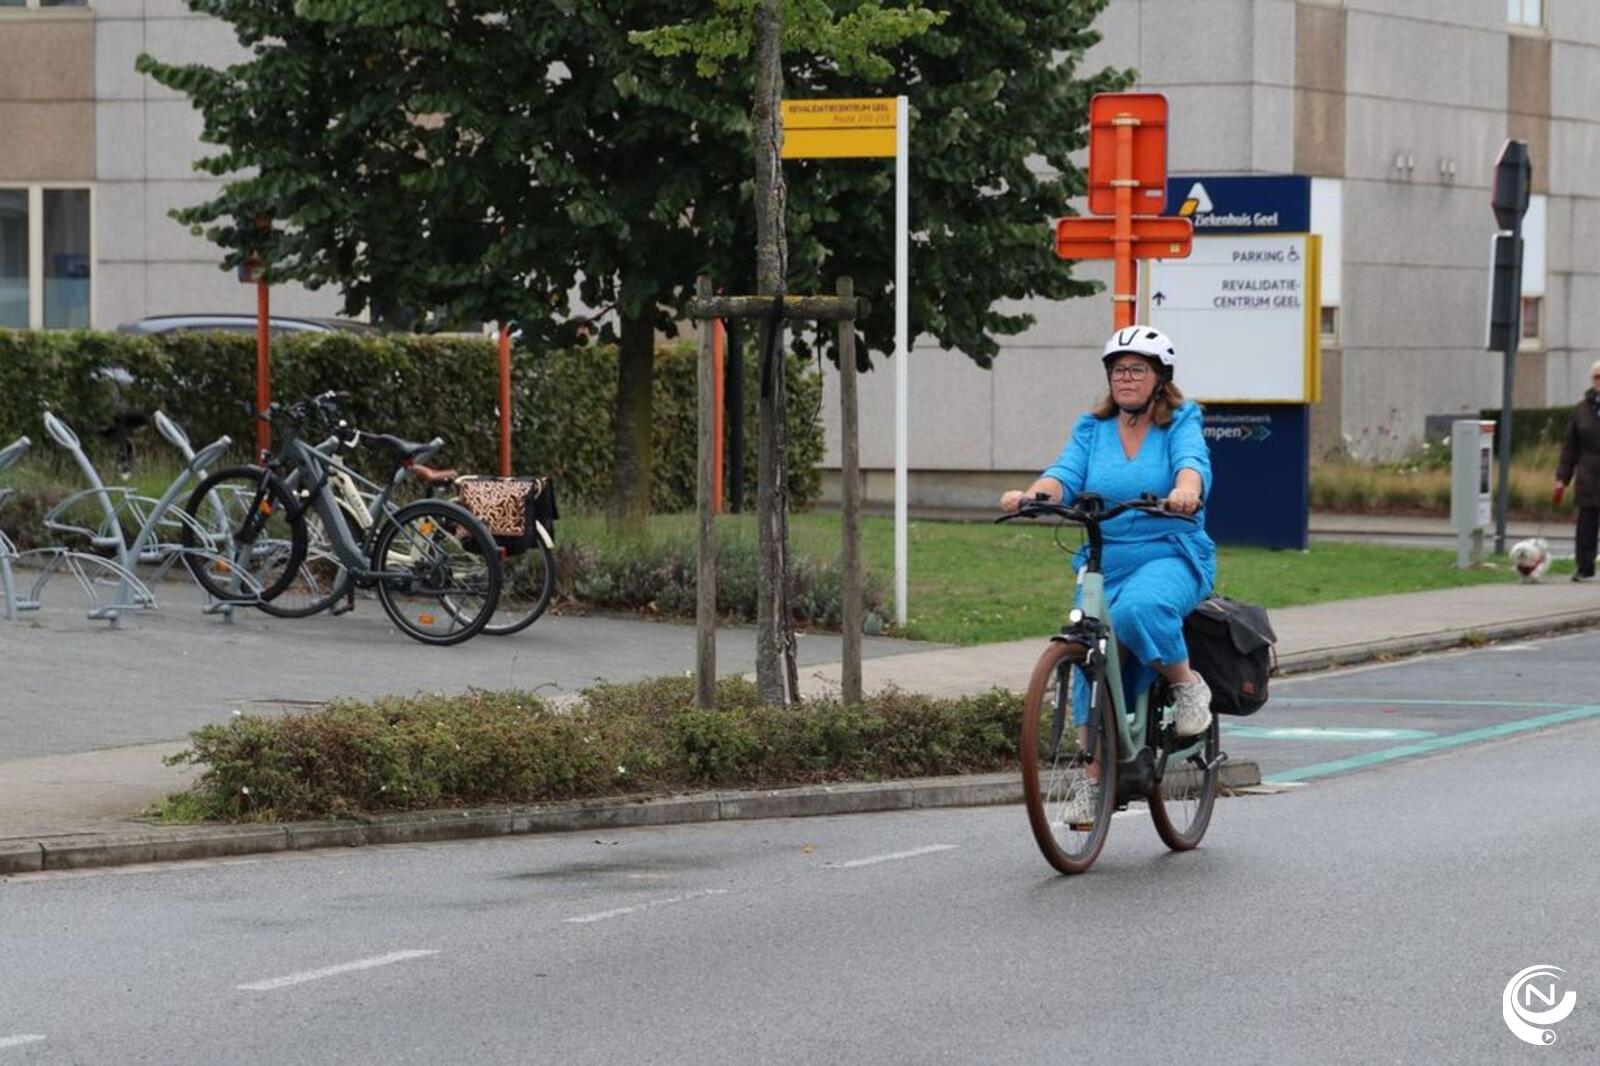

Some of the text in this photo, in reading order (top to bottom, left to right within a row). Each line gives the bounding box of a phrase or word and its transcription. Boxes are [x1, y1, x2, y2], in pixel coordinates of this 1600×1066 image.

[1194, 212, 1279, 227] Ziekenhuis Geel
[1232, 250, 1284, 262] PARKING
[1222, 279, 1301, 292] REVALIDATIE-
[1213, 295, 1301, 308] CENTRUM GEEL
[1203, 426, 1241, 441] mpen
